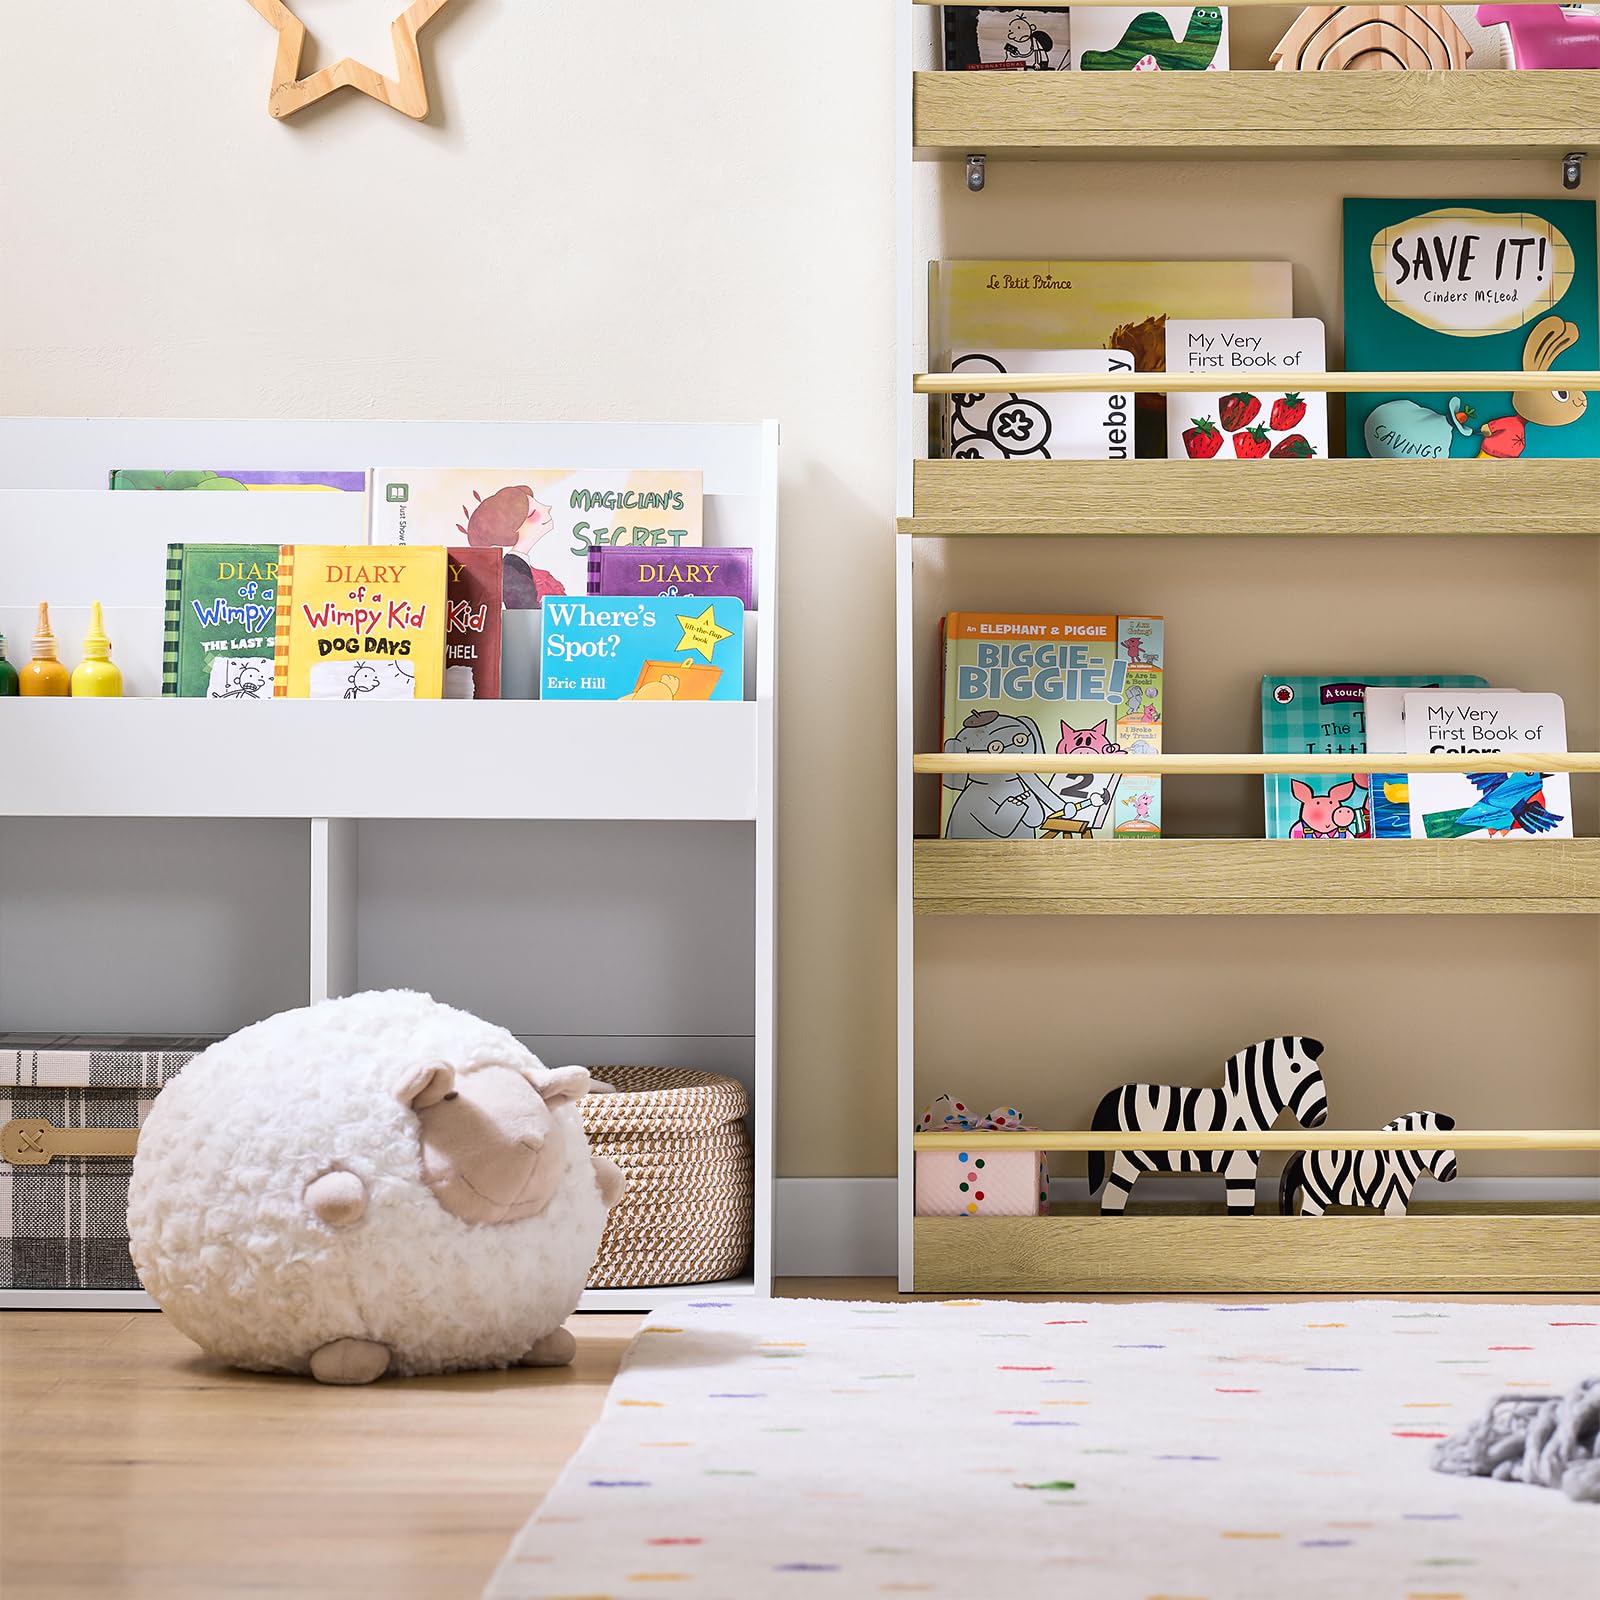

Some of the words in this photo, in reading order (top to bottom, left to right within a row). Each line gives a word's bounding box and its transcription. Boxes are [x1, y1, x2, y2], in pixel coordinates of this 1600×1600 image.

[968, 61, 1024, 69] INTERNATIONAL
[1392, 235, 1480, 284] SAVE
[1495, 237, 1546, 282] IT!
[986, 274, 1000, 290] Le
[1003, 274, 1030, 289] Petit
[1033, 274, 1072, 289] Prince
[1424, 290, 1468, 302] Cinders
[1475, 289, 1518, 303] McLeod
[1188, 333, 1215, 351] My
[1220, 333, 1262, 351] Very
[1189, 352, 1224, 367] First
[1231, 352, 1277, 367] Book
[1283, 351, 1302, 366] of
[1373, 424, 1442, 459] SAVINGS
[570, 488, 684, 512] MAGICIAN'S
[326, 565, 406, 583] DIARY
[638, 565, 719, 583] DIARY
[238, 581, 257, 599] of
[262, 589, 274, 599] a
[348, 586, 366, 602] of
[372, 593, 382, 603] a
[192, 598, 275, 633] Wimpy
[302, 602, 383, 636] Wimpy
[387, 600, 427, 630] Kid
[447, 600, 488, 632] Kid
[547, 603, 657, 627] Where's
[703, 619, 710, 627] A
[980, 624, 1047, 635] ELEPHANT
[1050, 627, 1060, 635] &
[1064, 625, 1107, 636] PIGGIE
[200, 641, 229, 652] THE
[231, 638, 263, 649] LAST
[318, 638, 359, 656] DOG
[364, 637, 411, 656] DAYS
[446, 645, 478, 659] HEEL
[547, 633, 621, 662] Spot?
[547, 677, 577, 689] Eric
[580, 677, 606, 689] Hill
[957, 659, 1129, 705] BIGGIE!
[1325, 689, 1334, 698] A
[1334, 689, 1365, 698] touch
[1428, 706, 1454, 725] My
[1456, 706, 1498, 725] Very
[1321, 722, 1351, 736] The
[1429, 725, 1466, 740] First
[1472, 725, 1519, 740] Book
[1524, 725, 1543, 740] of
